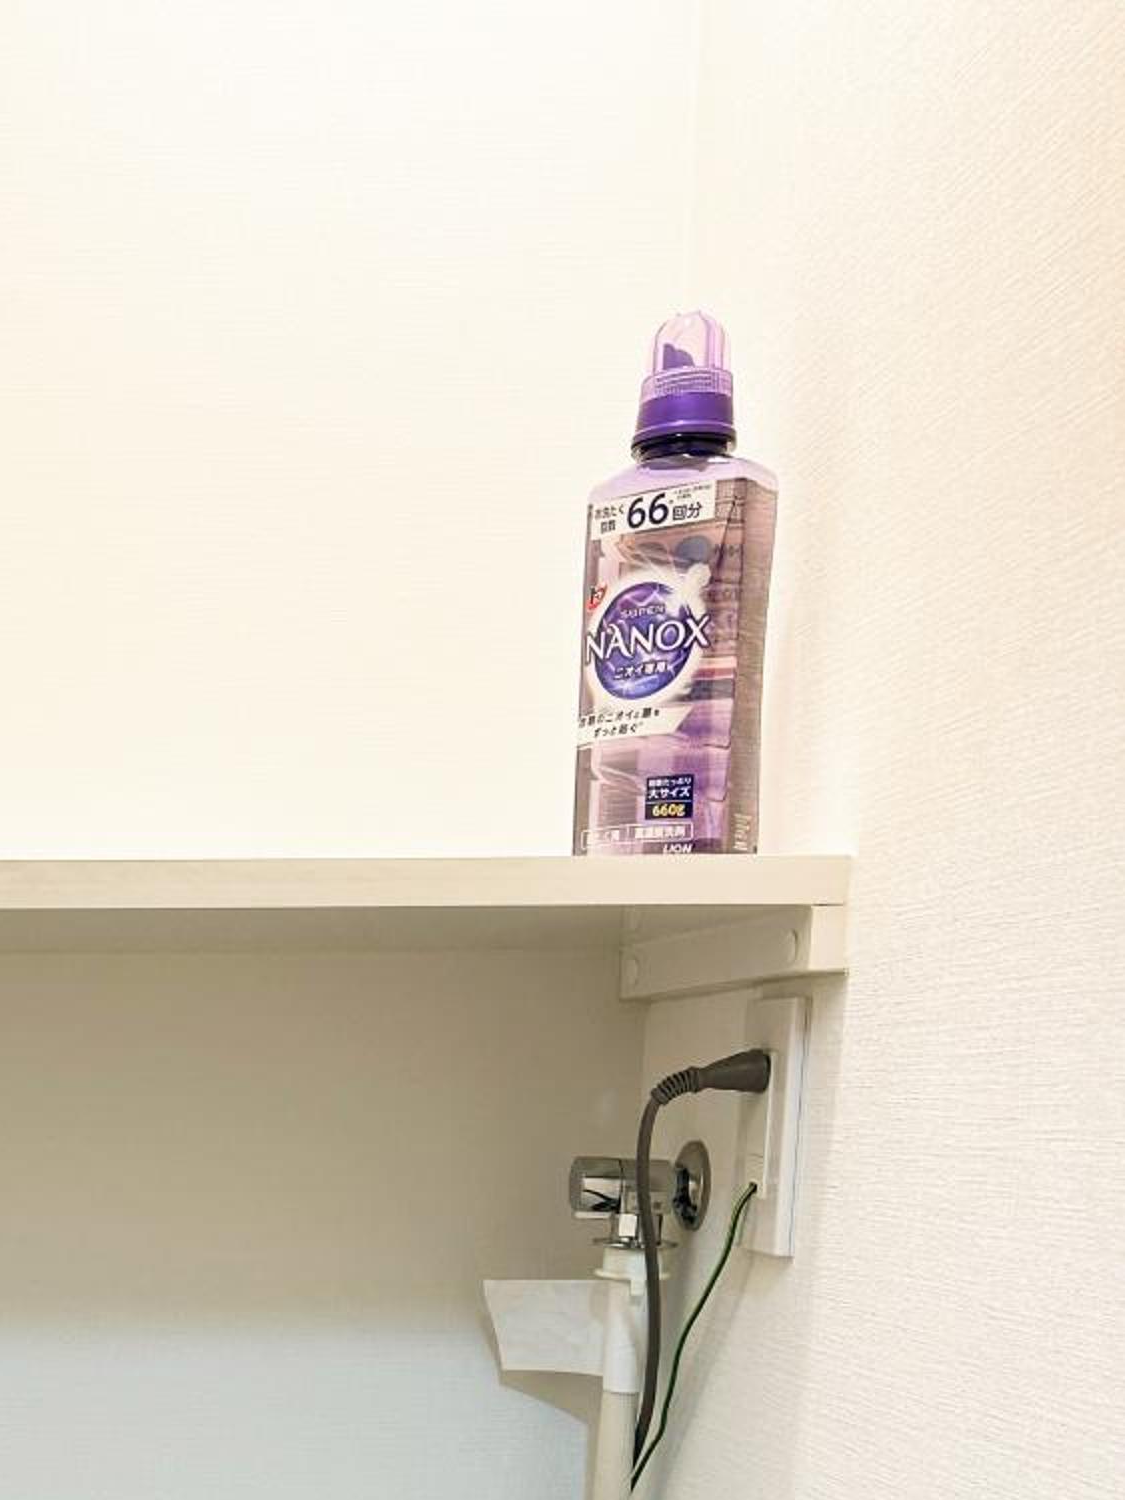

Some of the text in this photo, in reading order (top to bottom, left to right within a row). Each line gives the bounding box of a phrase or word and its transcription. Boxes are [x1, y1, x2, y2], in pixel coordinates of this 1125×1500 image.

[627, 492, 702, 528] 66 回分
[585, 613, 711, 664] NANOX
[648, 786, 692, 800] 大サイズ
